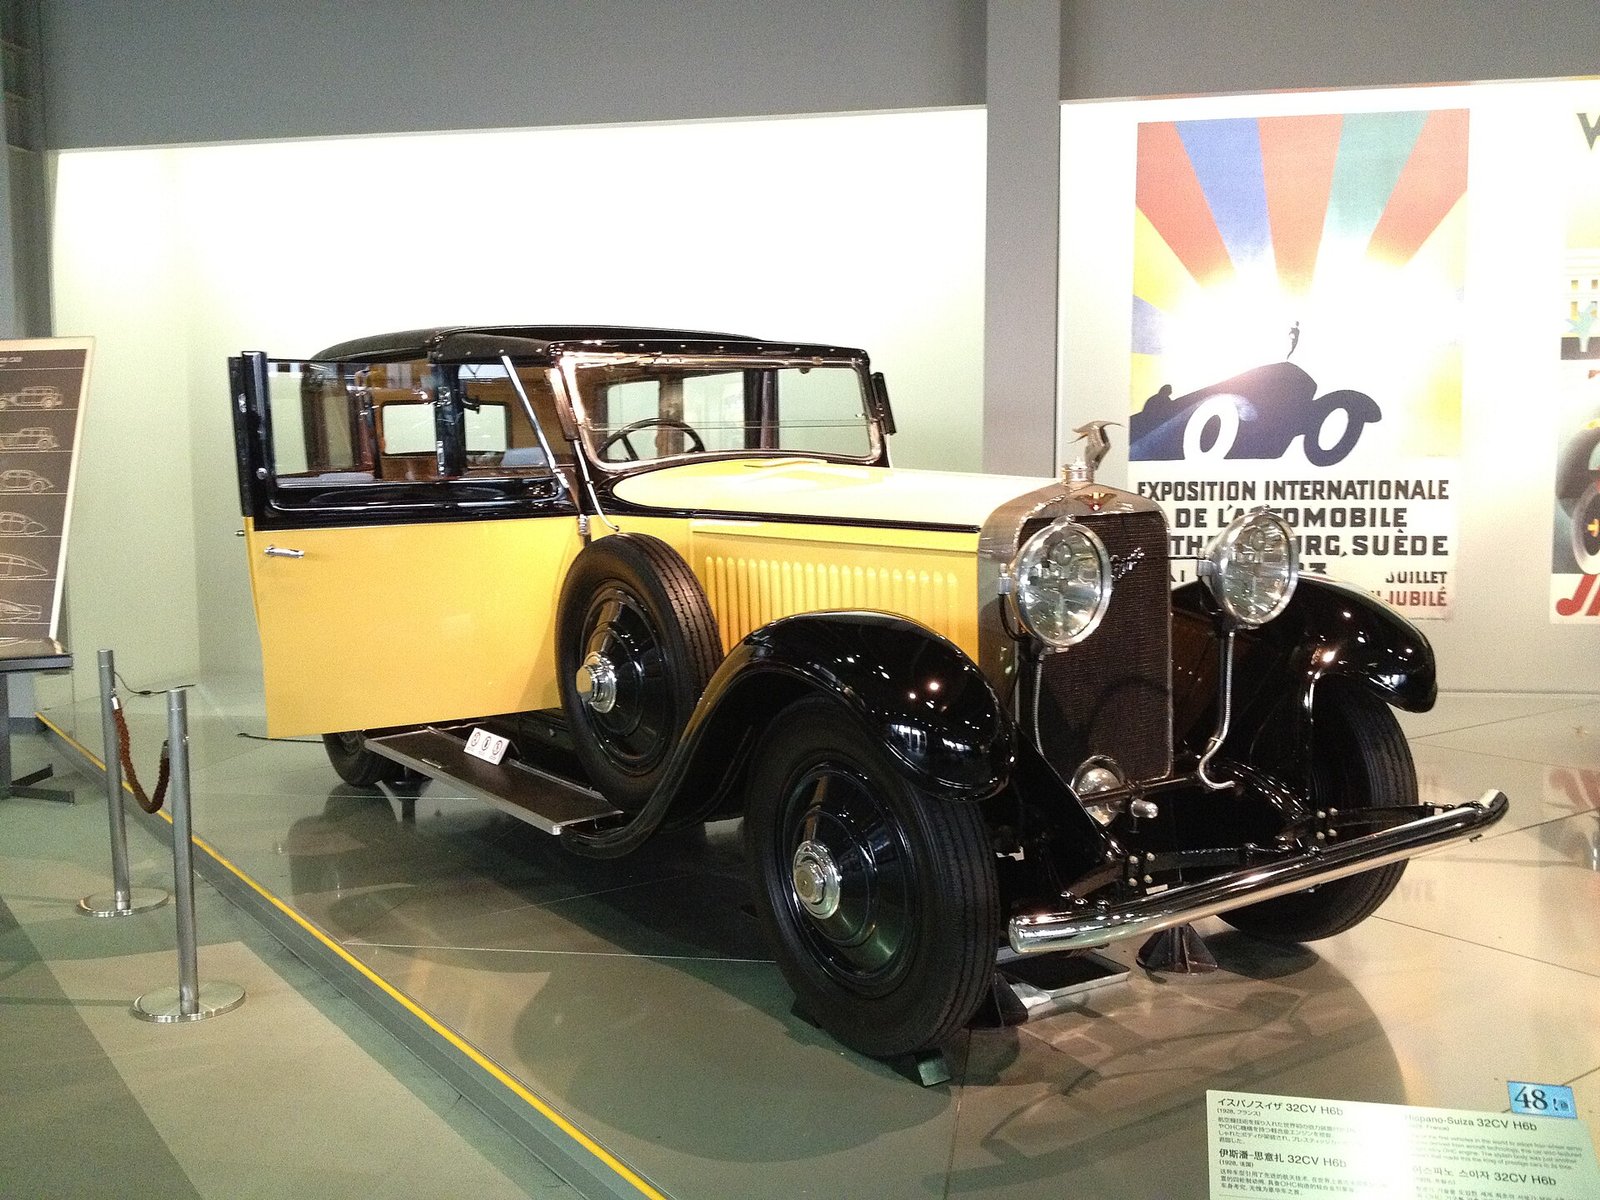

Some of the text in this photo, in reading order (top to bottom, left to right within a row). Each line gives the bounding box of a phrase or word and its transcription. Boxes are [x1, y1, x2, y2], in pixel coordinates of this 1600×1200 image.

[1138, 479, 1449, 501] EXPOSITION INTERNATIONALE
[1175, 508, 1207, 528] DE
[1352, 529, 1449, 556] SUÈDE
[1385, 571, 1447, 584] JUILLET
[1514, 1086, 1549, 1111] 48
[1285, 1103, 1317, 1114] 32CV
[1320, 1105, 1344, 1117] H6b
[1477, 1117, 1509, 1129] 32CV
[1513, 1120, 1538, 1131] H6b
[1287, 1154, 1319, 1165] 32CV
[1323, 1156, 1347, 1168] H6b
[1494, 1172, 1527, 1184] 32CV
[1532, 1174, 1557, 1186] H6b
